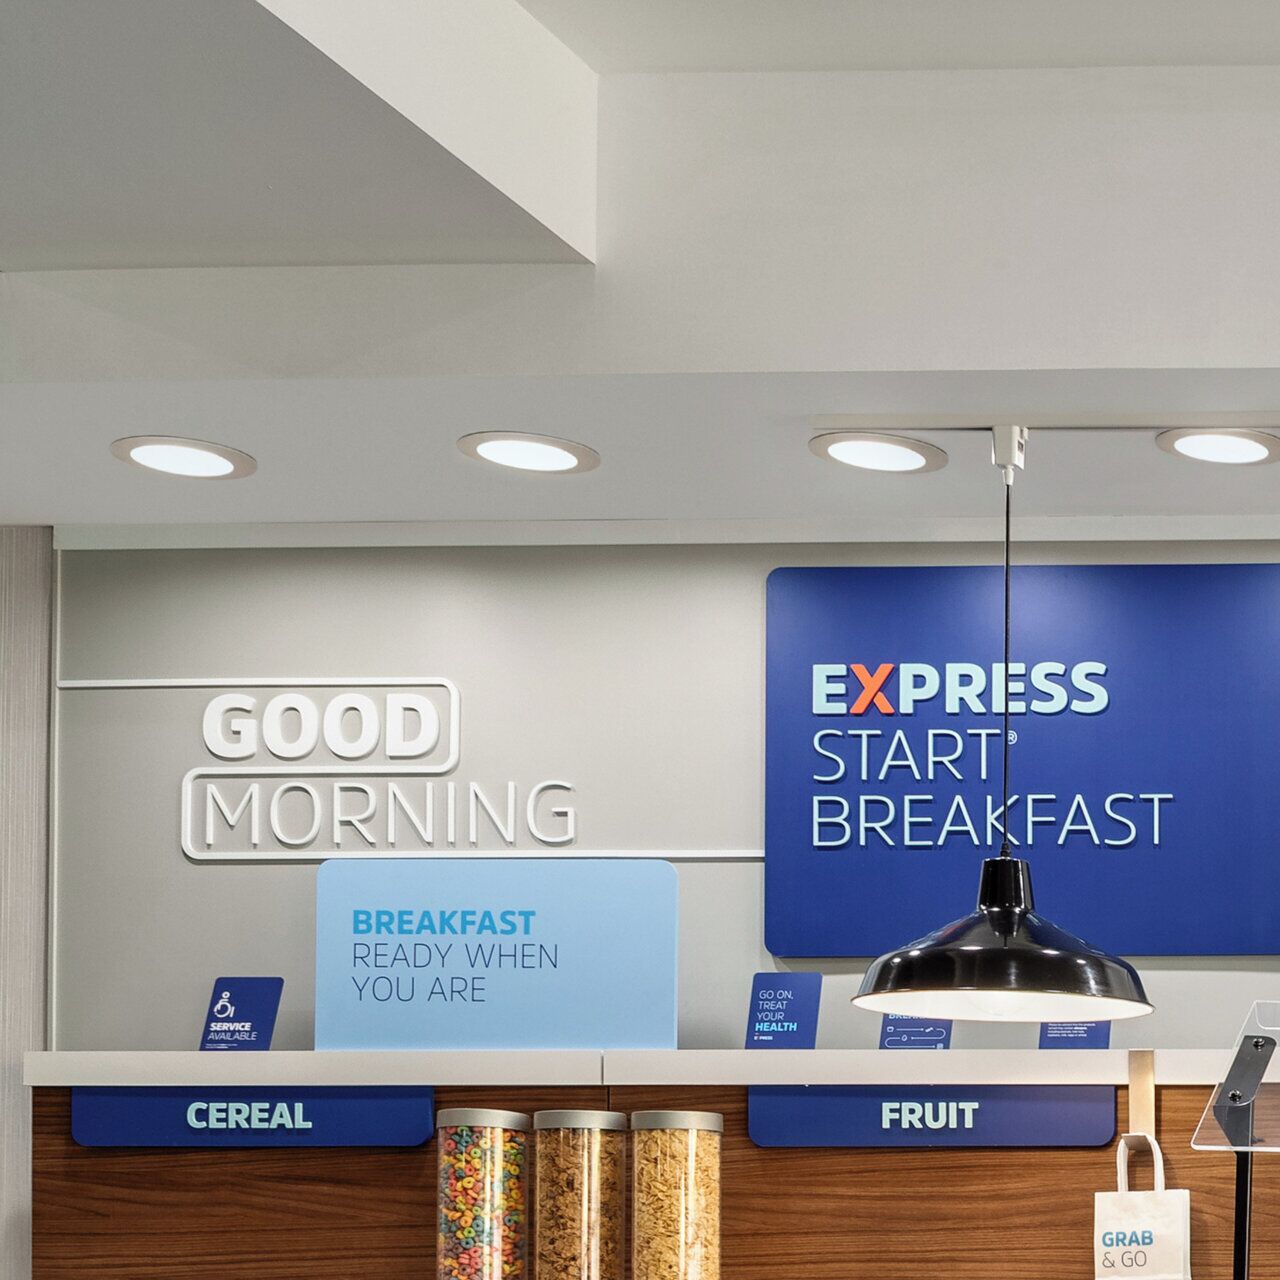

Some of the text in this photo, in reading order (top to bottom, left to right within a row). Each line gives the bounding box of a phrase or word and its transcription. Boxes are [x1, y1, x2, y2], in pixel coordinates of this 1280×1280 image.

[811, 661, 1110, 715] EXPRESS
[203, 692, 441, 759] GOOD
[204, 780, 577, 848] MORNING
[811, 793, 1173, 848] BREAKFAST
[352, 909, 537, 936] BREAKFAST
[353, 942, 558, 969] READY WHEN
[352, 976, 486, 1002] YOU ARE
[759, 990, 774, 1000] GO
[757, 1012, 784, 1020] YOUR
[759, 1001, 787, 1010] TREAT
[207, 1031, 258, 1041] AVAILABLE
[209, 1022, 252, 1031] SERVICE
[755, 1022, 797, 1032] HEALTH
[187, 1102, 312, 1129] CEREAL
[882, 1102, 979, 1129] FRUIT
[1102, 1230, 1153, 1247] GRAB
[1102, 1251, 1147, 1268] & GO
